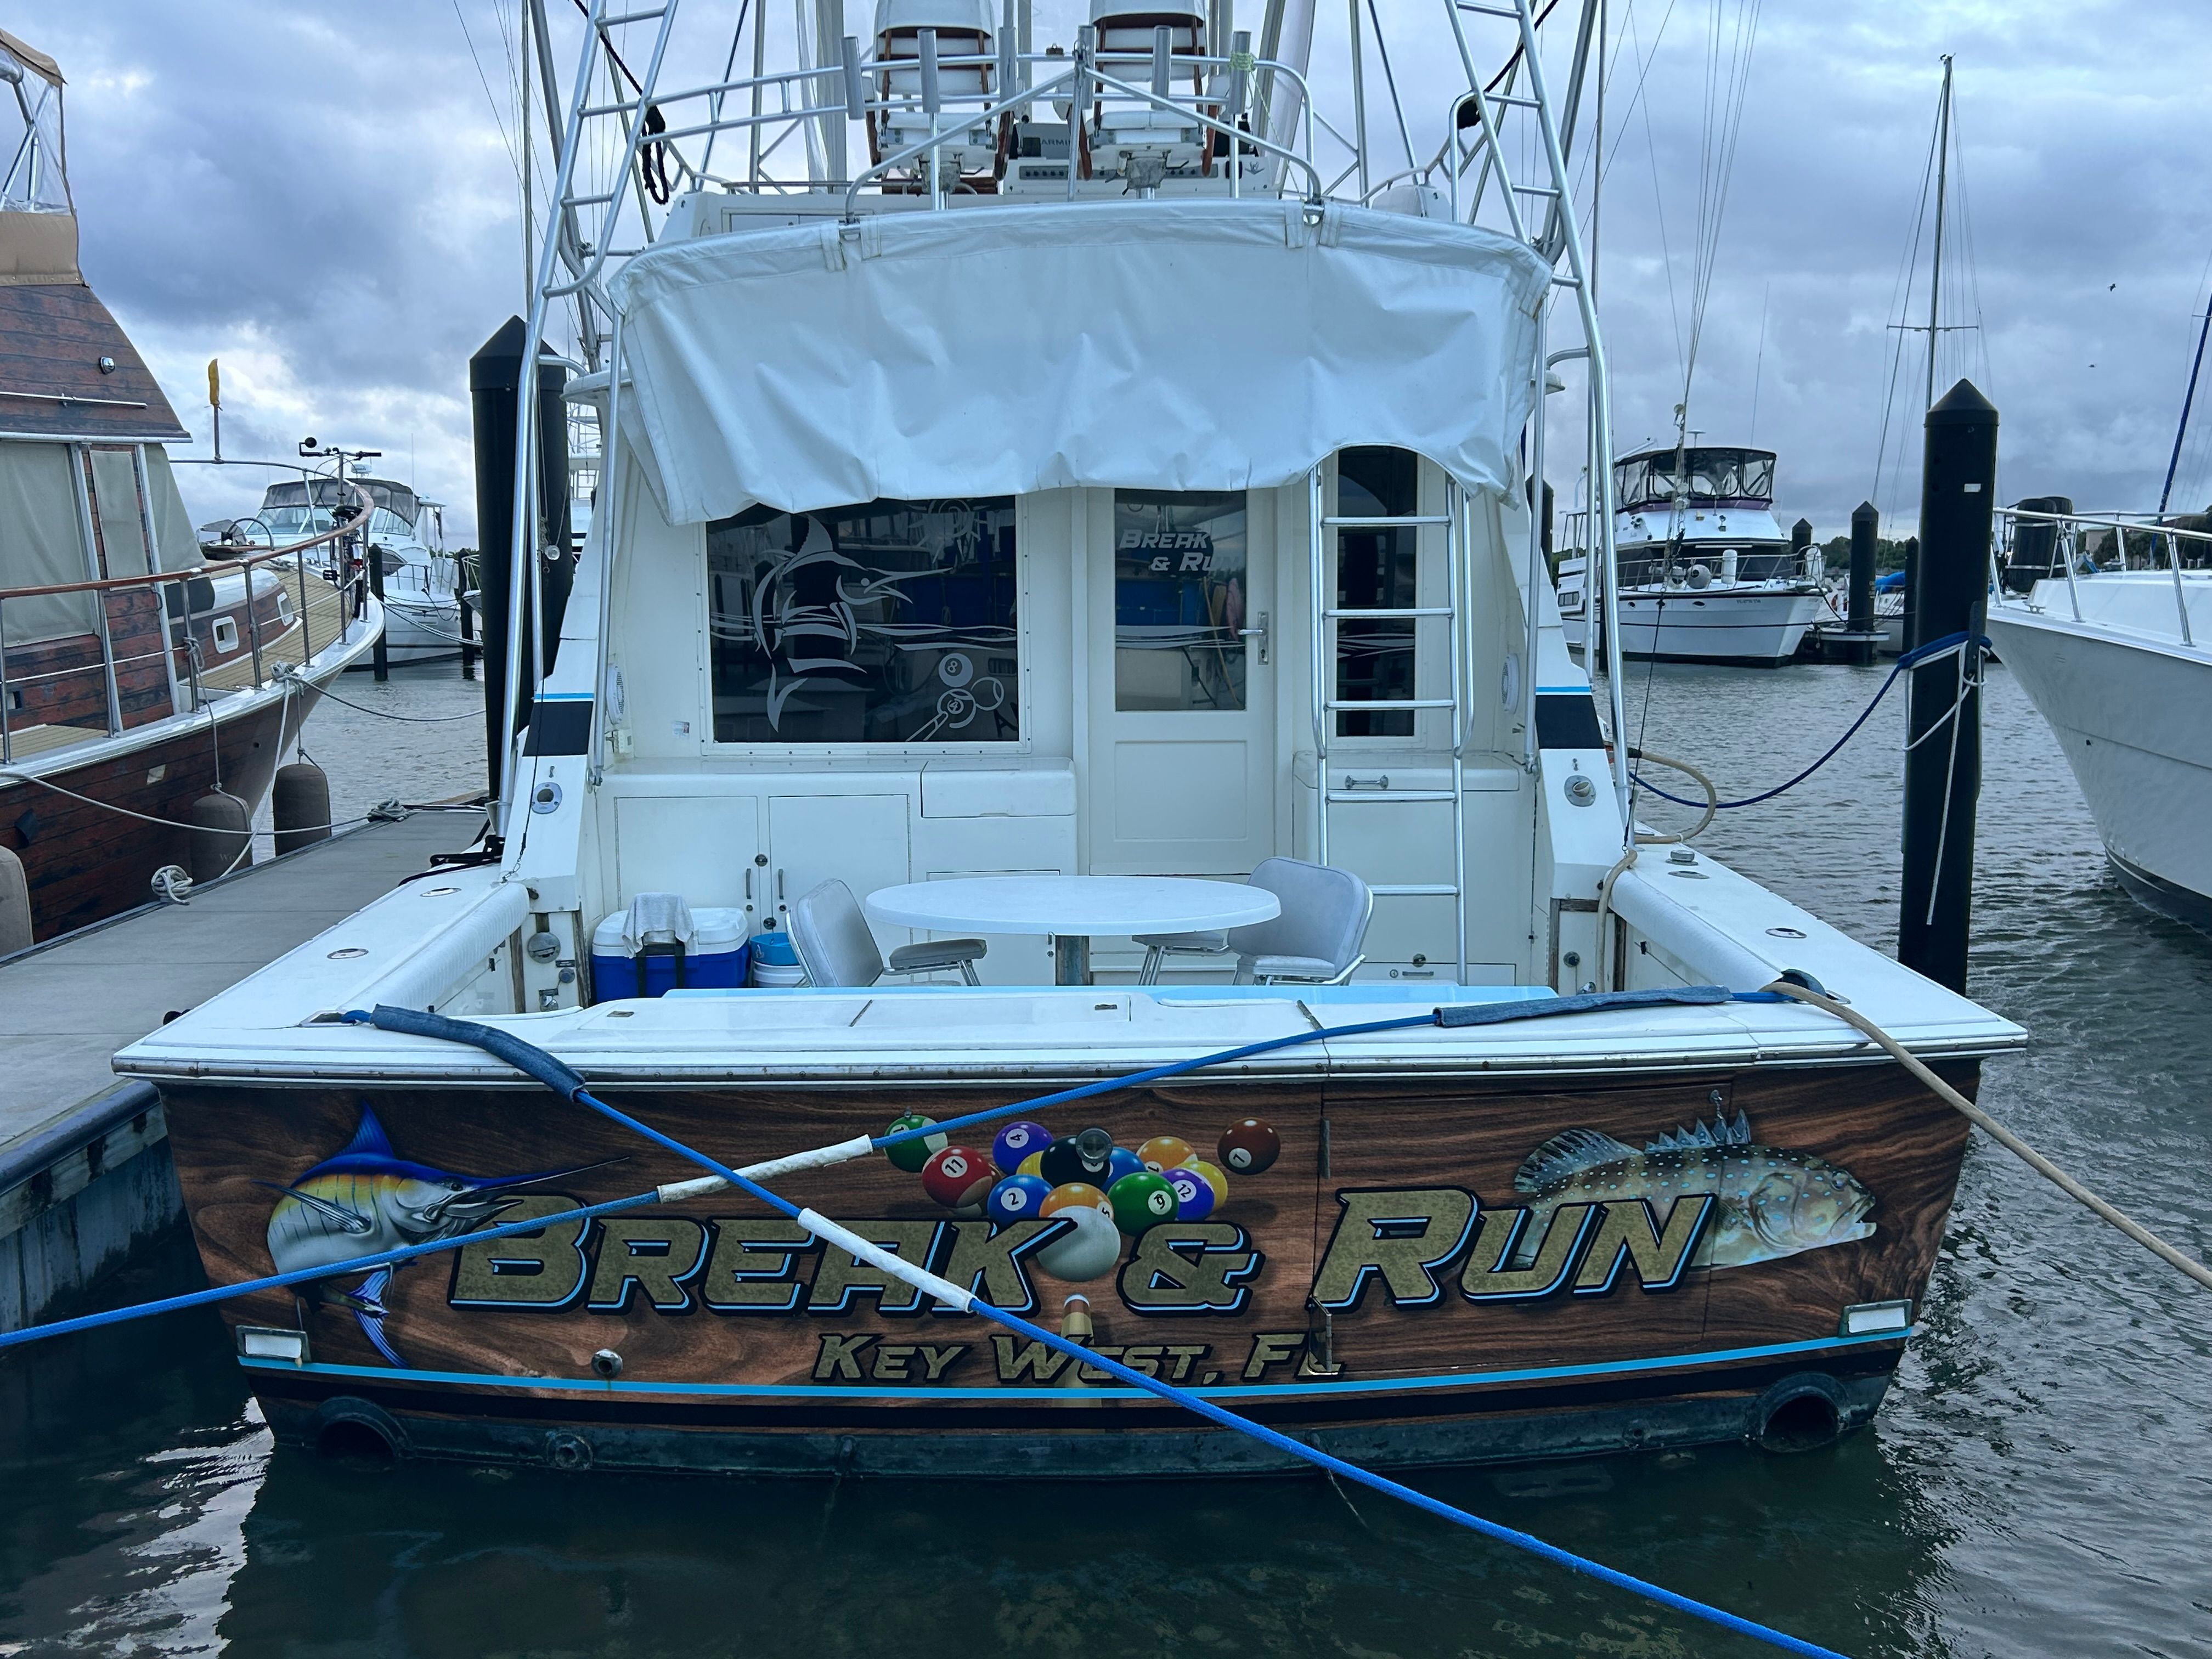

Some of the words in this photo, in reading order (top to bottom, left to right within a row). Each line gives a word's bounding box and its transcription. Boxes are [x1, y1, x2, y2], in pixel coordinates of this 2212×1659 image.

[1119, 529, 1210, 549] BREAK
[1151, 556, 1171, 571] &
[947, 660, 958, 674] 8
[1010, 1133, 1022, 1142] 4
[1233, 1153, 1245, 1163] 7
[945, 1159, 963, 1173] 11
[1177, 1183, 1192, 1198] 12
[1008, 1193, 1019, 1206] 2
[448, 1192, 1076, 1316] BREAK
[1116, 1221, 1264, 1316] &
[1306, 1186, 1716, 1309] RUN
[812, 1334, 973, 1382] KEY
